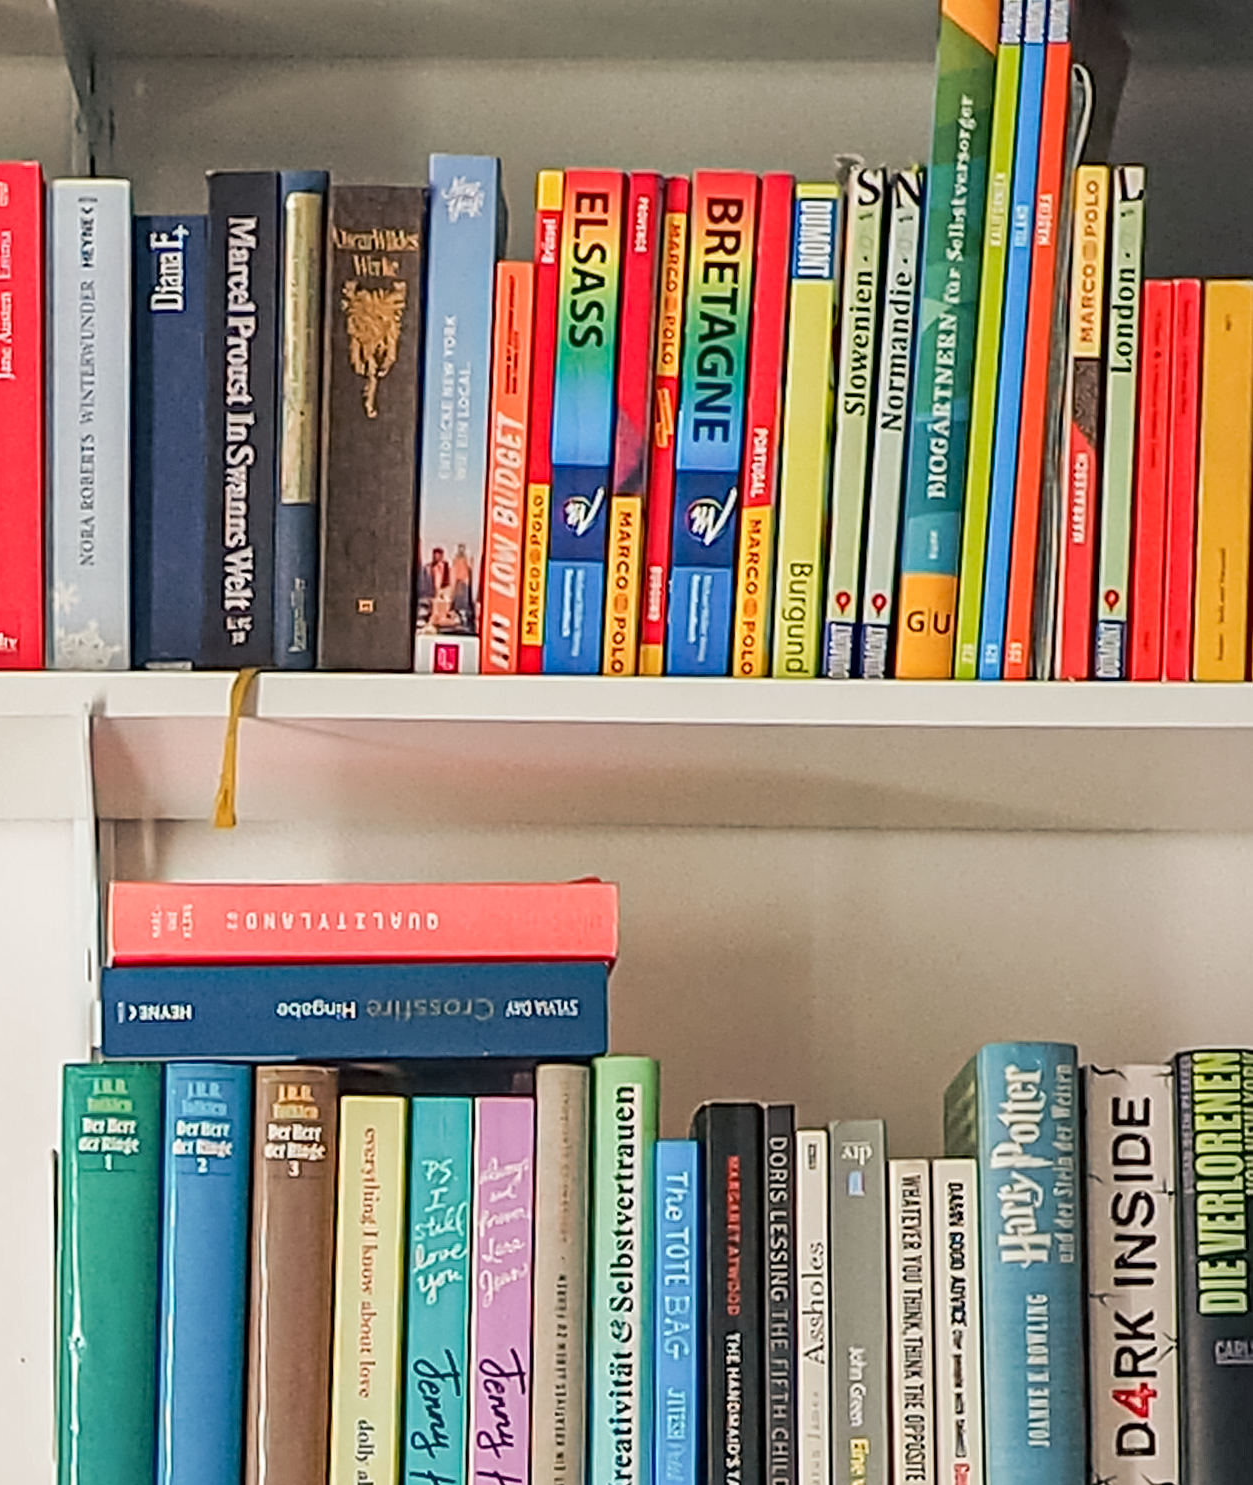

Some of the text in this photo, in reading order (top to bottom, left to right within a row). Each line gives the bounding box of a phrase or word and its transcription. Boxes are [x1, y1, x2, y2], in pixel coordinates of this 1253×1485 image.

[149, 251, 184, 312] Diana
[226, 216, 258, 312] Marcel
[568, 190, 610, 348] ELSASS
[661, 221, 682, 364] MARCO POLO
[1079, 180, 1099, 343] MARCO POLO
[226, 316, 255, 405] Proust
[692, 196, 744, 443] BRETAGNE
[843, 271, 874, 417] Slowenien
[881, 272, 913, 431] Normandie
[1110, 268, 1136, 373] London
[79, 280, 97, 566] NORA ROBERTS WINTERWUNDER
[226, 411, 254, 444] In
[926, 313, 958, 500] BIOGÄRTNERN
[224, 445, 254, 547] Swanns
[492, 411, 526, 529] BUDGET
[224, 547, 253, 611] Welt
[490, 533, 518, 598] LOW
[524, 495, 545, 636] MARCO POLO
[610, 511, 633, 674] MARCO POLO
[746, 519, 764, 596] MARCO
[740, 620, 757, 675] POLO
[781, 562, 814, 675] Burgund
[608, 1085, 635, 1313] Selbstvertrauen
[768, 1136, 789, 1203] DORIS
[902, 1174, 923, 1250] WHATEVER
[989, 1058, 1054, 1269] Harry Potter
[1050, 1063, 1075, 1263] und der Stein der Weisen
[1192, 1052, 1249, 1315] DIE VERLORENEN
[358, 1127, 382, 1399] everything I know about love
[412, 1242, 468, 1273] love
[663, 1171, 691, 1360] The TOTE BAG
[769, 1210, 789, 1302] LESSING
[801, 1241, 825, 1365] Assholes
[902, 1255, 923, 1284] YOU
[1109, 1096, 1158, 1458] D4RK INSIDE
[726, 1332, 741, 1364] THE
[770, 1309, 789, 1351] THE
[1025, 1293, 1050, 1365] ROWLING
[410, 1348, 461, 1459] Jenny
[476, 1348, 526, 1459] Jenny
[771, 1358, 790, 1419] FIFTH
[904, 1383, 925, 1410] THE
[1026, 1387, 1050, 1447] JOANNE
[354, 1419, 375, 1465] dolly
[904, 1414, 926, 1482] OPPOSITE
